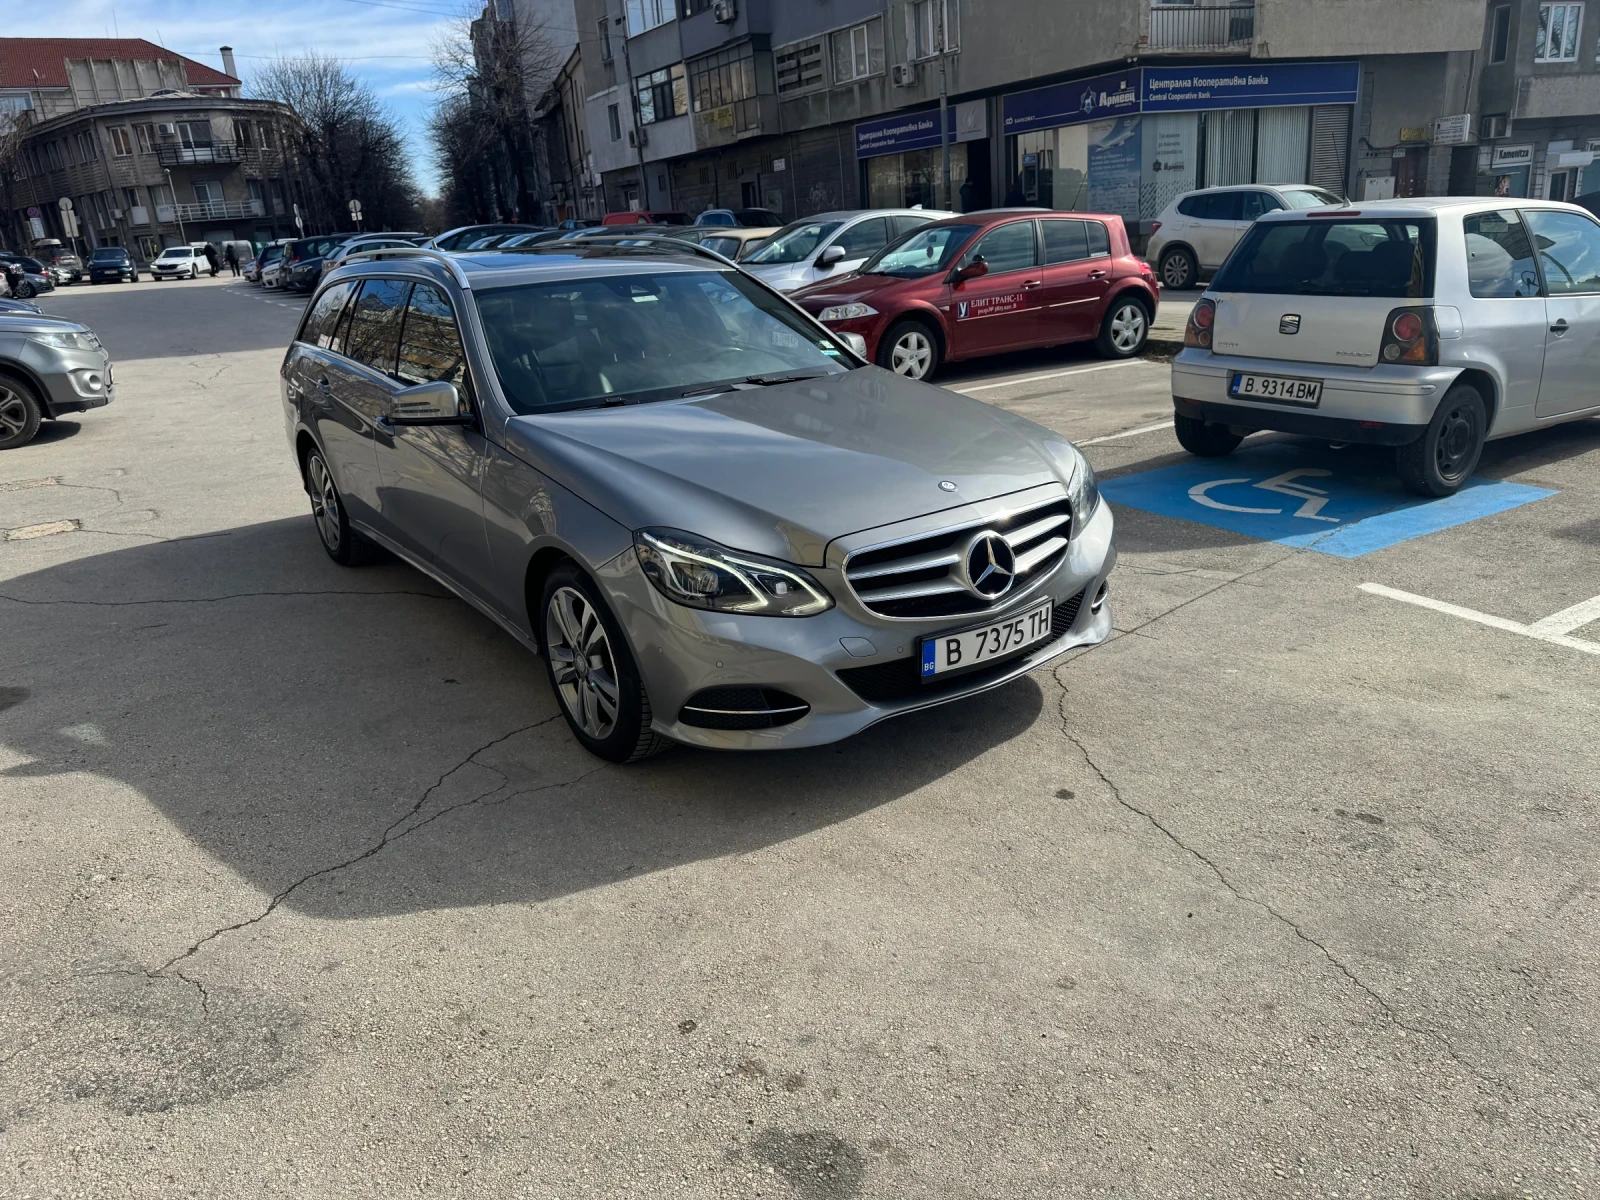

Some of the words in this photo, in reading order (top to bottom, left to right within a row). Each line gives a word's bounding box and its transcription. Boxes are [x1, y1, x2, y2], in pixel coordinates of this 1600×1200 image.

[1149, 79, 1191, 91] Централна
[1193, 76, 1246, 88] Кооперативна
[1247, 75, 1268, 85] Банка
[1098, 91, 1136, 107] Армеец
[1149, 93, 1167, 101] Central
[1168, 92, 1197, 101] Cooperative
[1198, 91, 1210, 99] Bank
[859, 130, 883, 143] Централна
[883, 123, 917, 137] Кооперативна
[918, 120, 933, 130] Банка
[1498, 149, 1529, 159] Kamenitza
[971, 298, 990, 308] ЕЛИТ
[991, 293, 1023, 305] ТРАНС-11
[1244, 378, 1255, 392] B
[1261, 379, 1294, 398] 9314
[1295, 384, 1318, 400] BM
[946, 638, 962, 666] B
[975, 619, 1024, 659] 7375
[1028, 607, 1050, 638] TH
[924, 662, 934, 671] BG
